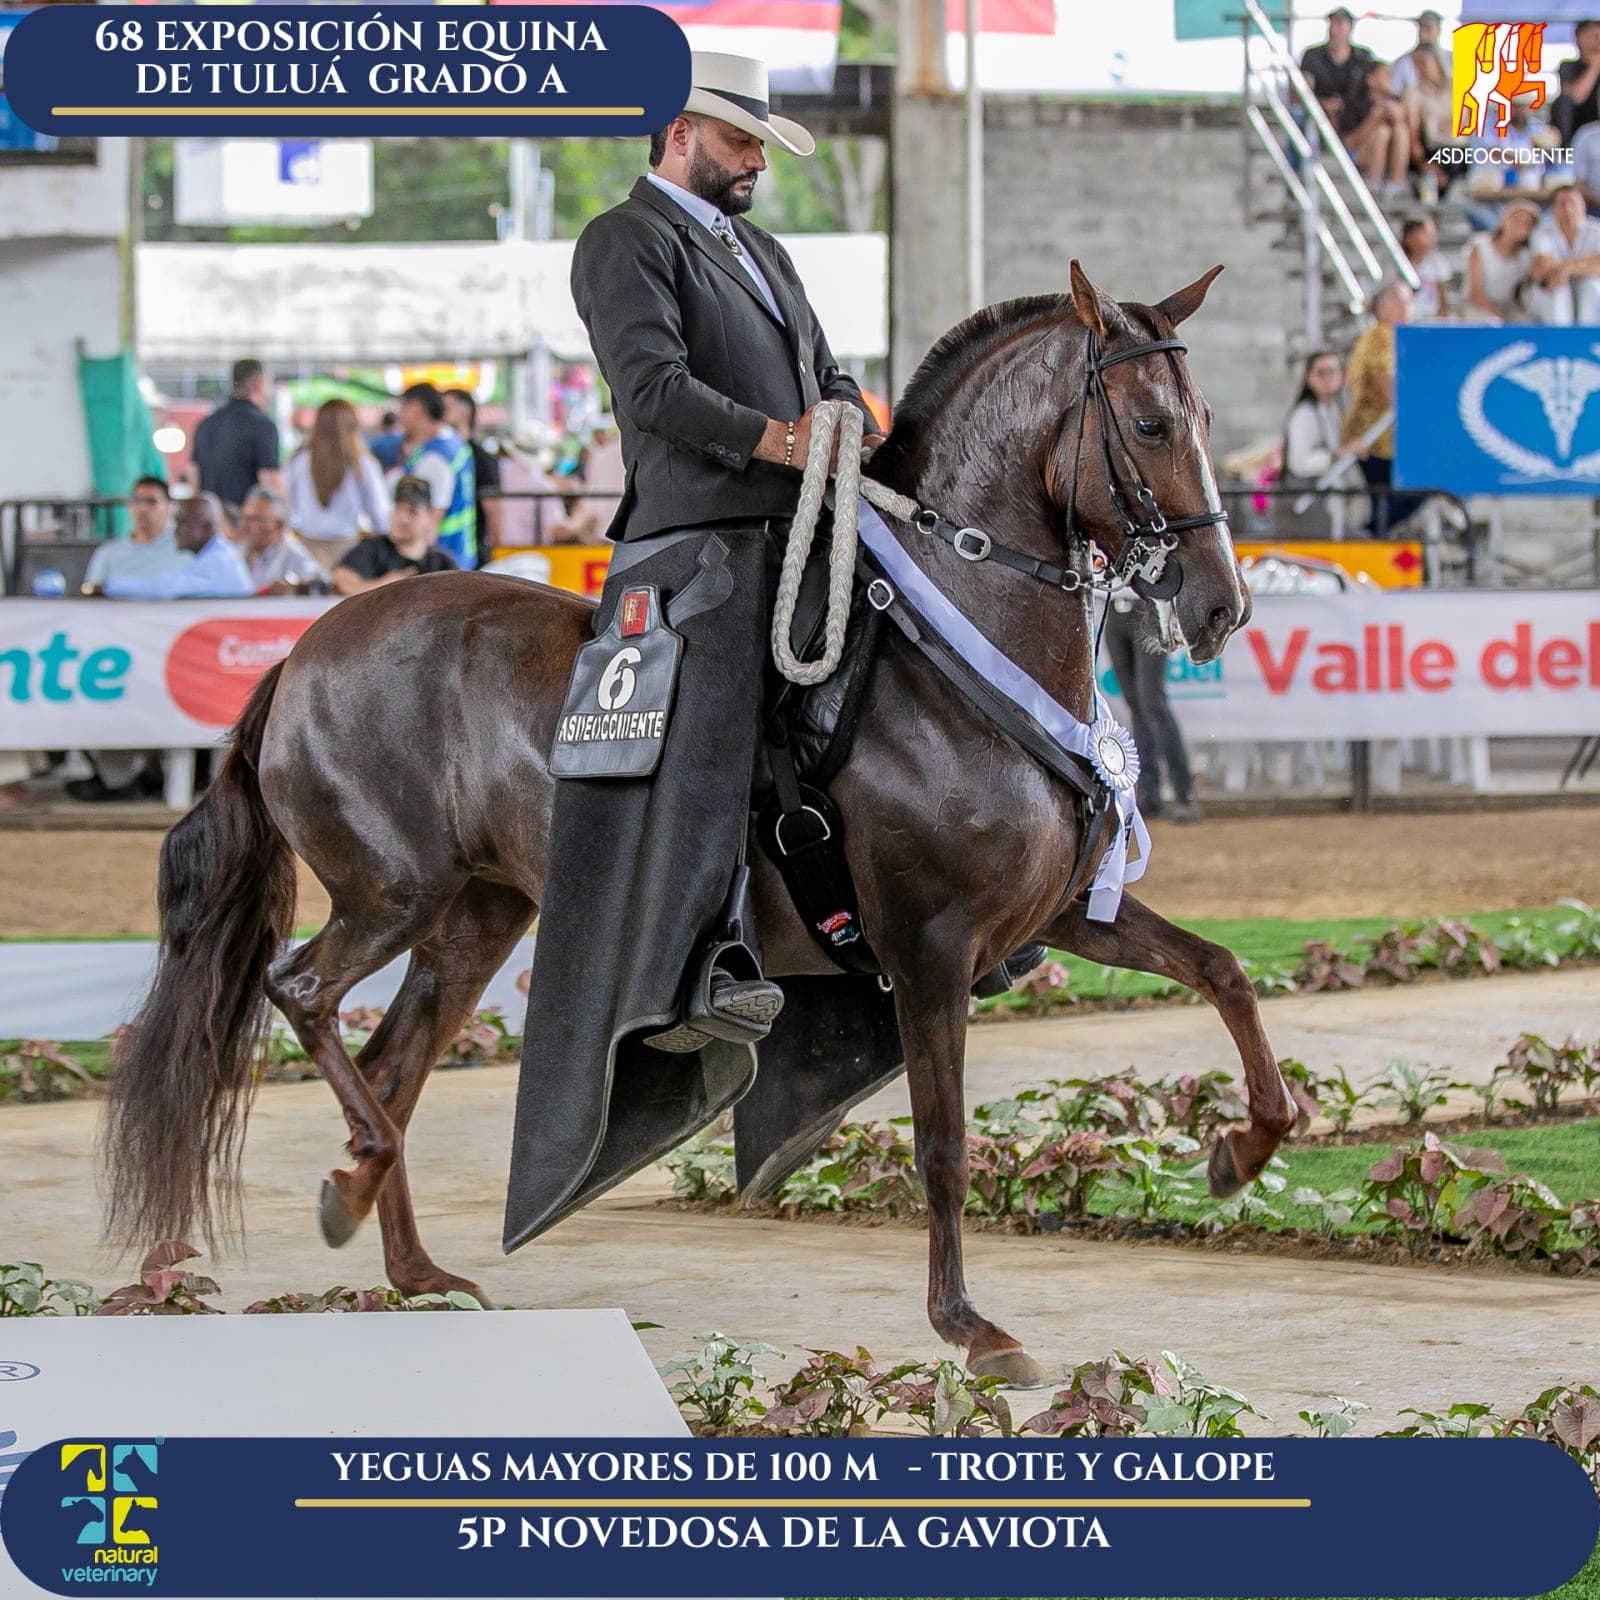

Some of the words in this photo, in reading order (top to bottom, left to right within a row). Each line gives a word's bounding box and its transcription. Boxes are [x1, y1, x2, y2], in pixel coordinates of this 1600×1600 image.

[597, 646, 643, 712] 6
[1246, 624, 1457, 696] Valle
[1480, 620, 1600, 692] del
